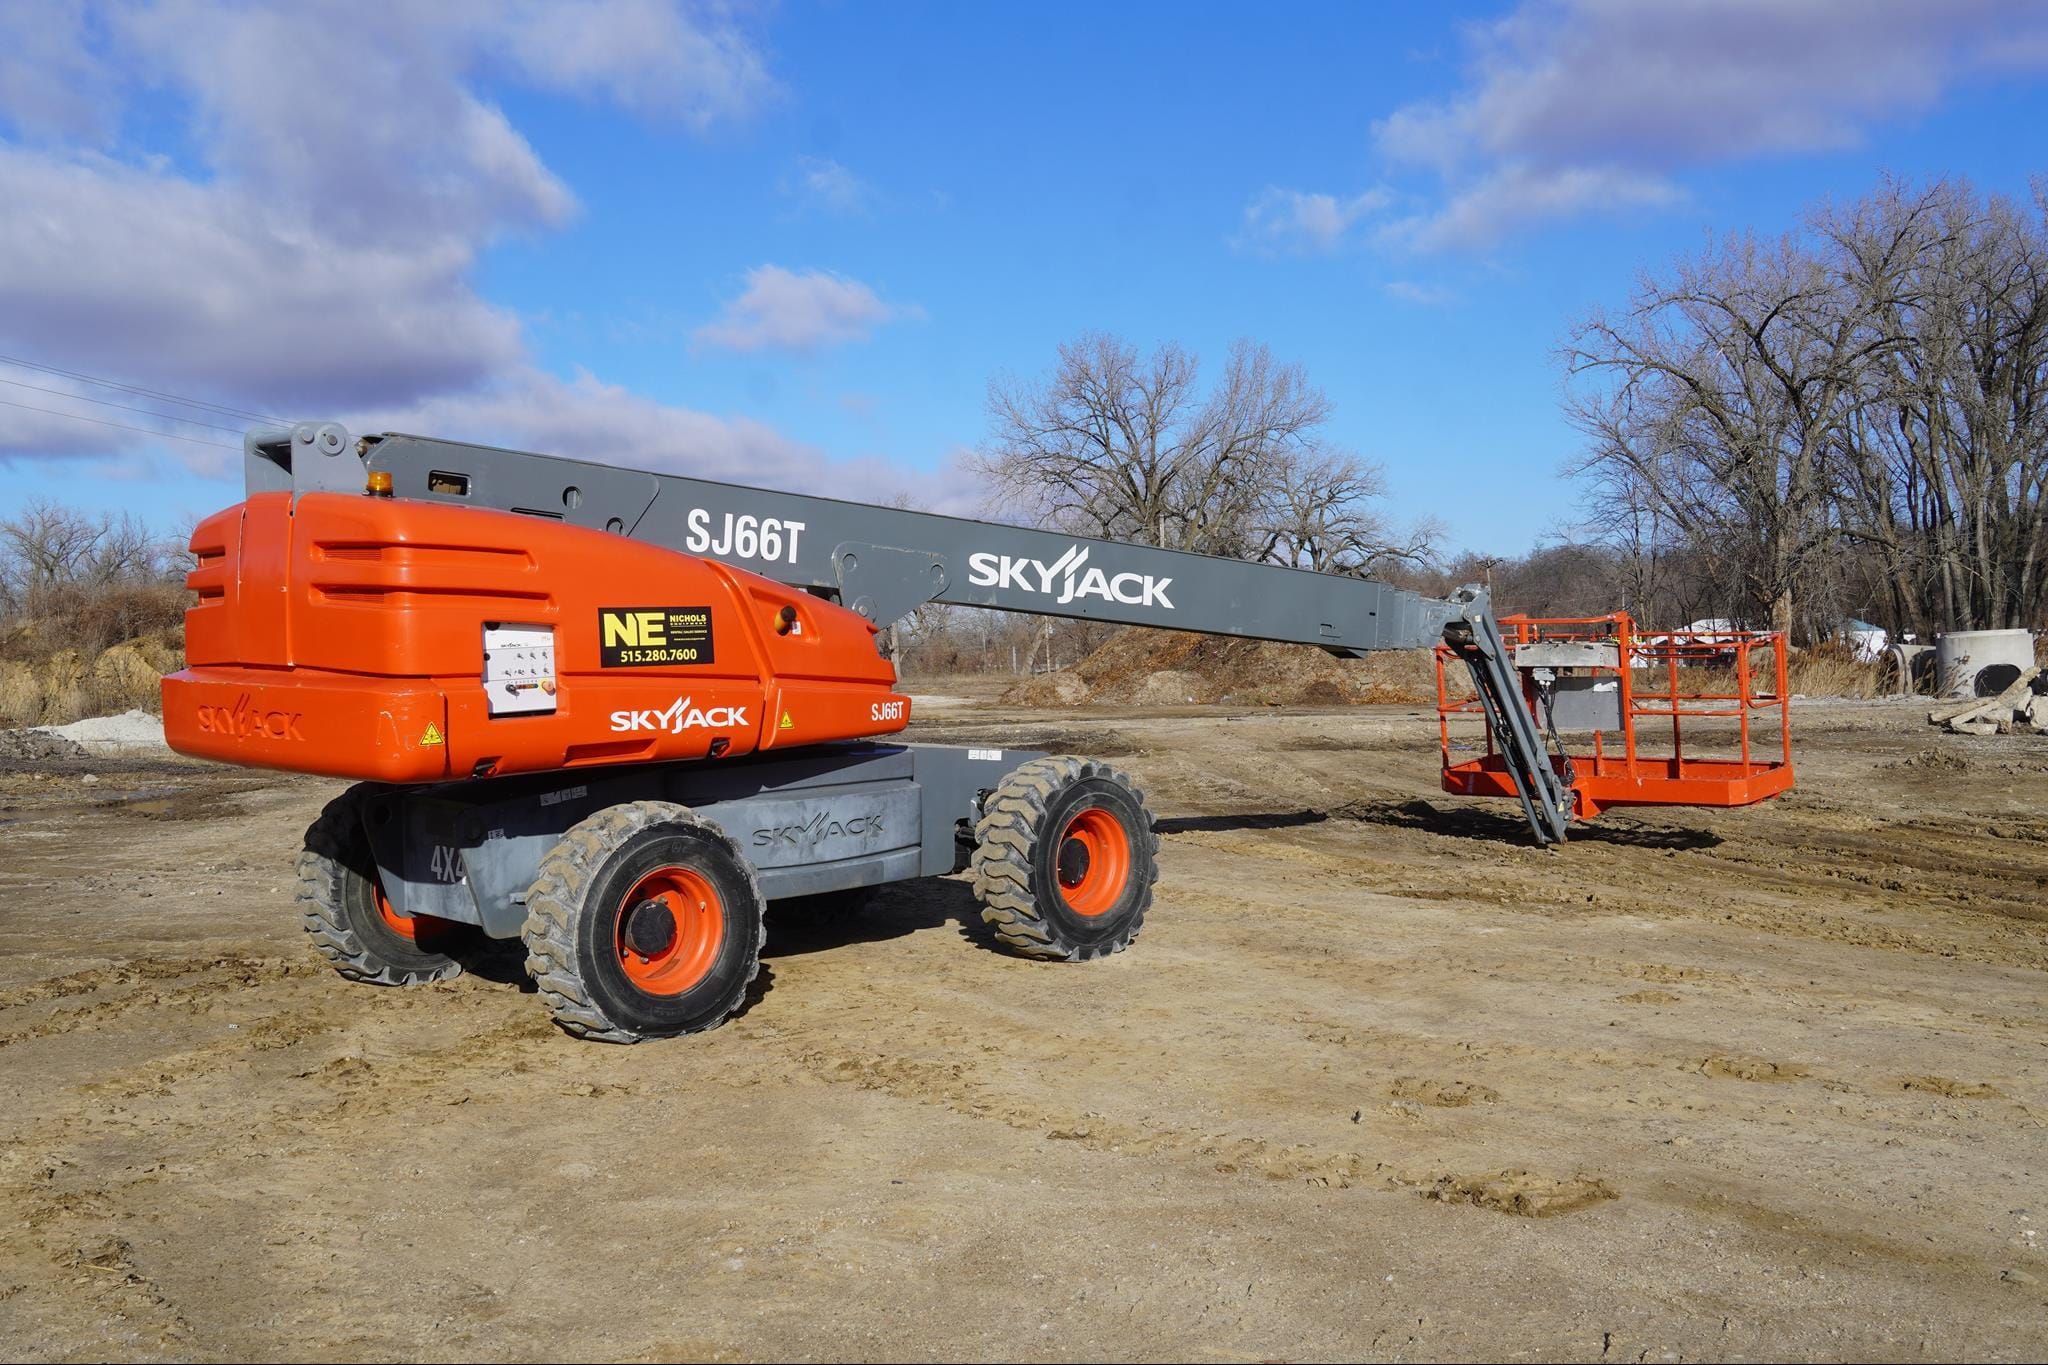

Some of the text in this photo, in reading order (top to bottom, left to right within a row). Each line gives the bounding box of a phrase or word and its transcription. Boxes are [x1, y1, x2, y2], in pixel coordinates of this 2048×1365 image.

[686, 508, 806, 564] SJ66T
[968, 544, 1175, 609] SKYJACK
[603, 612, 666, 647] NE
[669, 614, 707, 622] NICHOLS
[620, 649, 697, 662] 515.280.7600
[197, 693, 306, 743] SKYJACK
[610, 696, 749, 734] SKYJACK
[871, 701, 904, 721] SJ66T
[752, 812, 884, 846] SKYJACK
